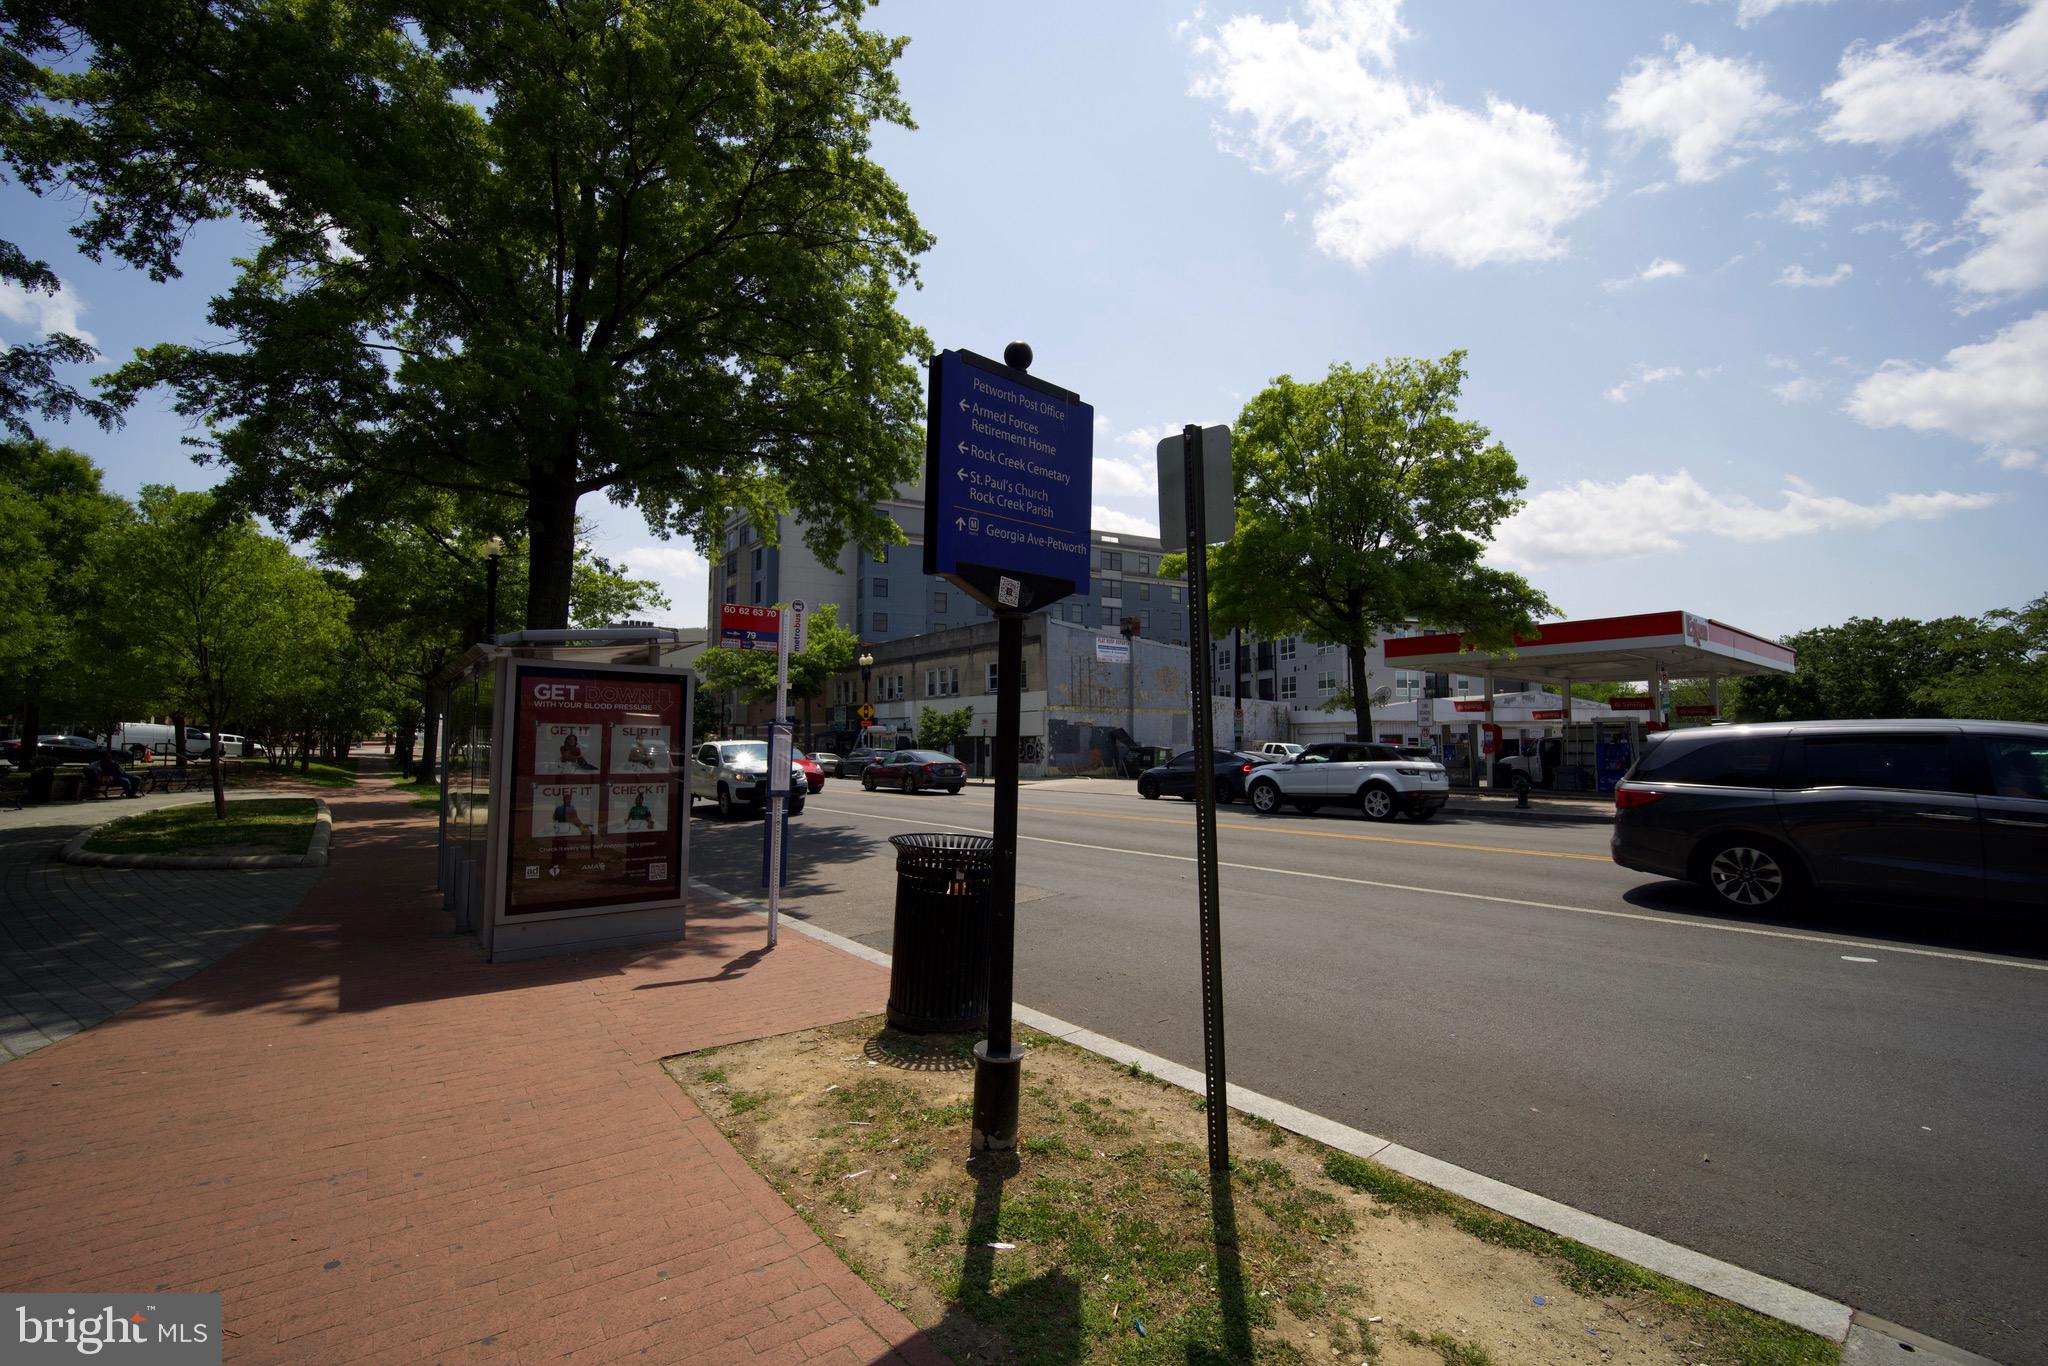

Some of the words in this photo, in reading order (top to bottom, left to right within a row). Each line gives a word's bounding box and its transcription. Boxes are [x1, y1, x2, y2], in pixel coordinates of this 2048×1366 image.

[974, 378, 1017, 403] Petworth
[1018, 394, 1038, 410] Post
[1040, 400, 1065, 421] Office
[972, 402, 1006, 424] Armed
[1009, 414, 1039, 435] Forces
[972, 419, 1026, 446] Retirement
[1028, 436, 1056, 456] Home
[970, 444, 996, 464] Rock
[998, 452, 1026, 471] Creek
[1028, 461, 1071, 486] Cemetary
[970, 470, 983, 485] St.
[1015, 482, 1048, 502] Church
[970, 487, 996, 504] Rock
[997, 494, 1025, 512] Creek
[1027, 501, 1054, 519] Parish
[986, 524, 1025, 544] Georgia
[1027, 533, 1087, 556] Ave-Petworth
[724, 606, 736, 614] 60
[752, 608, 764, 616] 63
[766, 610, 776, 618] 70
[534, 683, 580, 701] GET
[585, 686, 654, 704] DOWN
[534, 700, 556, 708] WITH
[584, 702, 612, 710] BLOOD
[550, 726, 578, 735] GET
[622, 728, 648, 737] SLIP
[652, 728, 661, 736] IT
[542, 787, 577, 797] CUFF
[580, 786, 592, 796] IT
[612, 786, 653, 796] CHECK
[656, 785, 666, 794] IT
